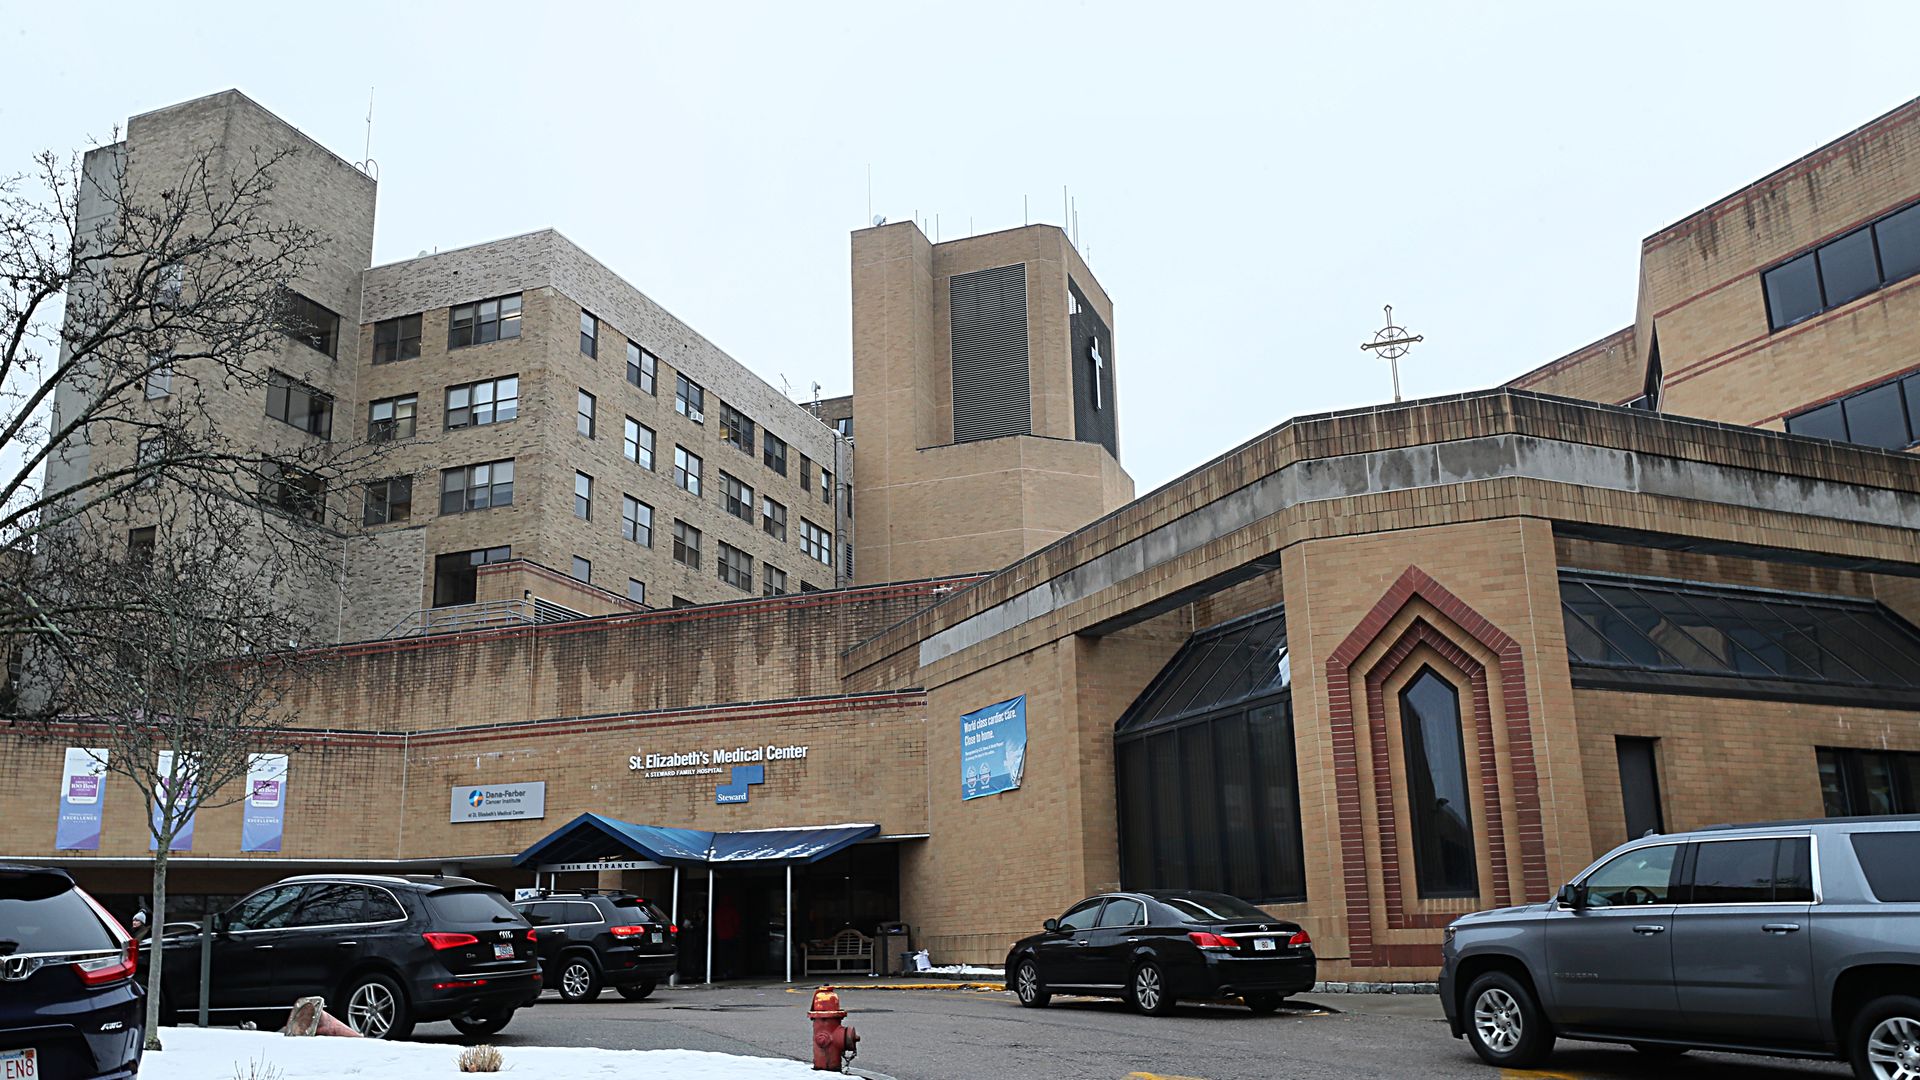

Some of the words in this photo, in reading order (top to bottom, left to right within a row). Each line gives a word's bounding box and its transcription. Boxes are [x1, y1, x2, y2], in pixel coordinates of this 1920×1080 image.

[964, 720, 976, 733] World
[977, 718, 987, 730] class
[988, 712, 1004, 726] cardiac
[1005, 709, 1017, 721] care.
[965, 735, 976, 746] Close
[981, 730, 994, 742] home.
[629, 755, 644, 770] St.
[645, 751, 710, 769] Elizabeth's
[713, 746, 763, 764] Medical
[766, 745, 809, 760] Center
[650, 770, 675, 778] STEWARD
[696, 767, 723, 775] HOSPITAL
[486, 790, 526, 798] Dana-Farber
[717, 792, 746, 801] Steward
